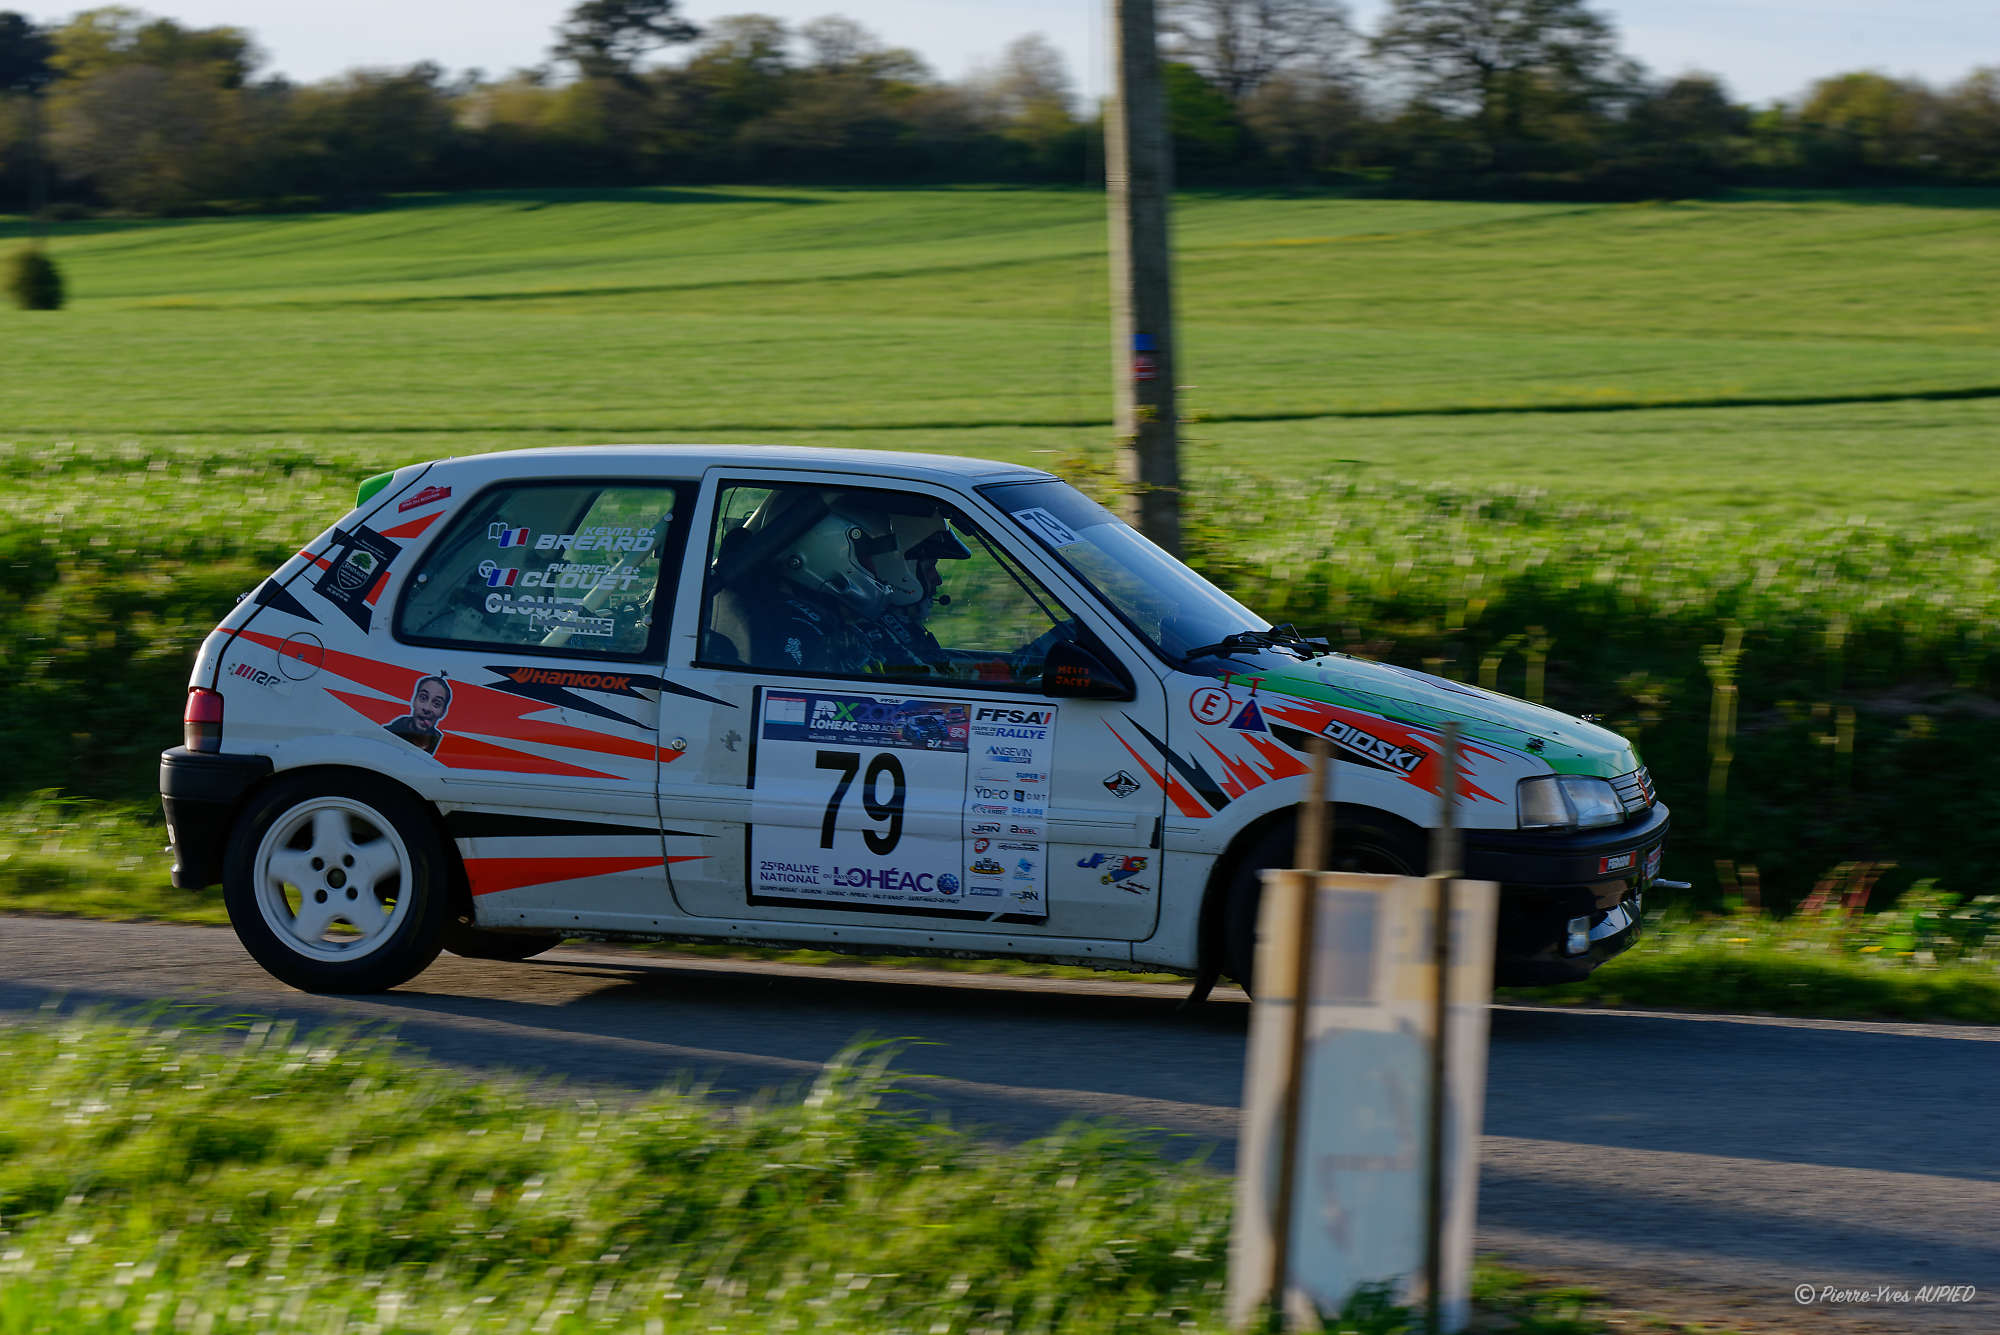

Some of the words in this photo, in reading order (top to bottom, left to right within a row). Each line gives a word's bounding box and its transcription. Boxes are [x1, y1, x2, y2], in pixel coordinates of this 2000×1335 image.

[583, 527, 631, 536] KEVIN
[1019, 512, 1075, 543] 79
[534, 534, 655, 551] BREARD
[520, 571, 640, 591] CLOUET
[1200, 694, 1220, 715] E
[976, 708, 1042, 724] FFSA
[810, 719, 858, 732] LOHEAC
[995, 727, 1047, 740] RALLYE
[1322, 719, 1423, 771] DIOSKI
[815, 750, 906, 856] 79
[777, 862, 819, 874] RALLYE
[760, 871, 820, 884] NATIONAL
[833, 866, 933, 892] LOHÉAC
